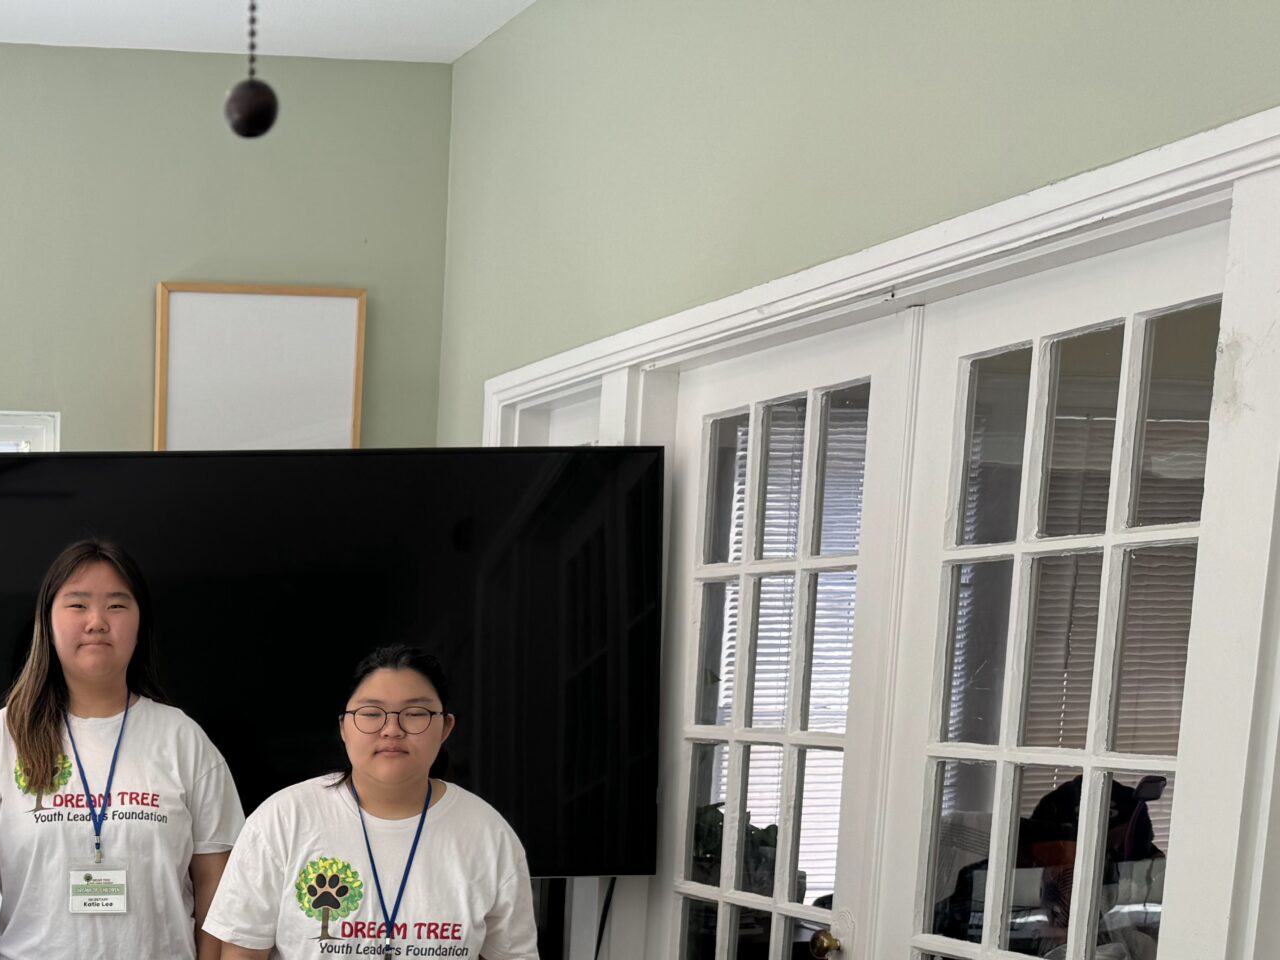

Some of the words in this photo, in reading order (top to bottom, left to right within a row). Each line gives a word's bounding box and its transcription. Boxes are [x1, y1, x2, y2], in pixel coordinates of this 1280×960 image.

[117, 791, 160, 808] TREE
[34, 812, 64, 824] Youth
[67, 812, 108, 822] Leads
[112, 810, 168, 823] Foundation
[414, 922, 462, 940] TREE
[320, 942, 352, 955] Youth
[356, 943, 402, 956] Leadrs
[405, 945, 469, 956] Foundation
